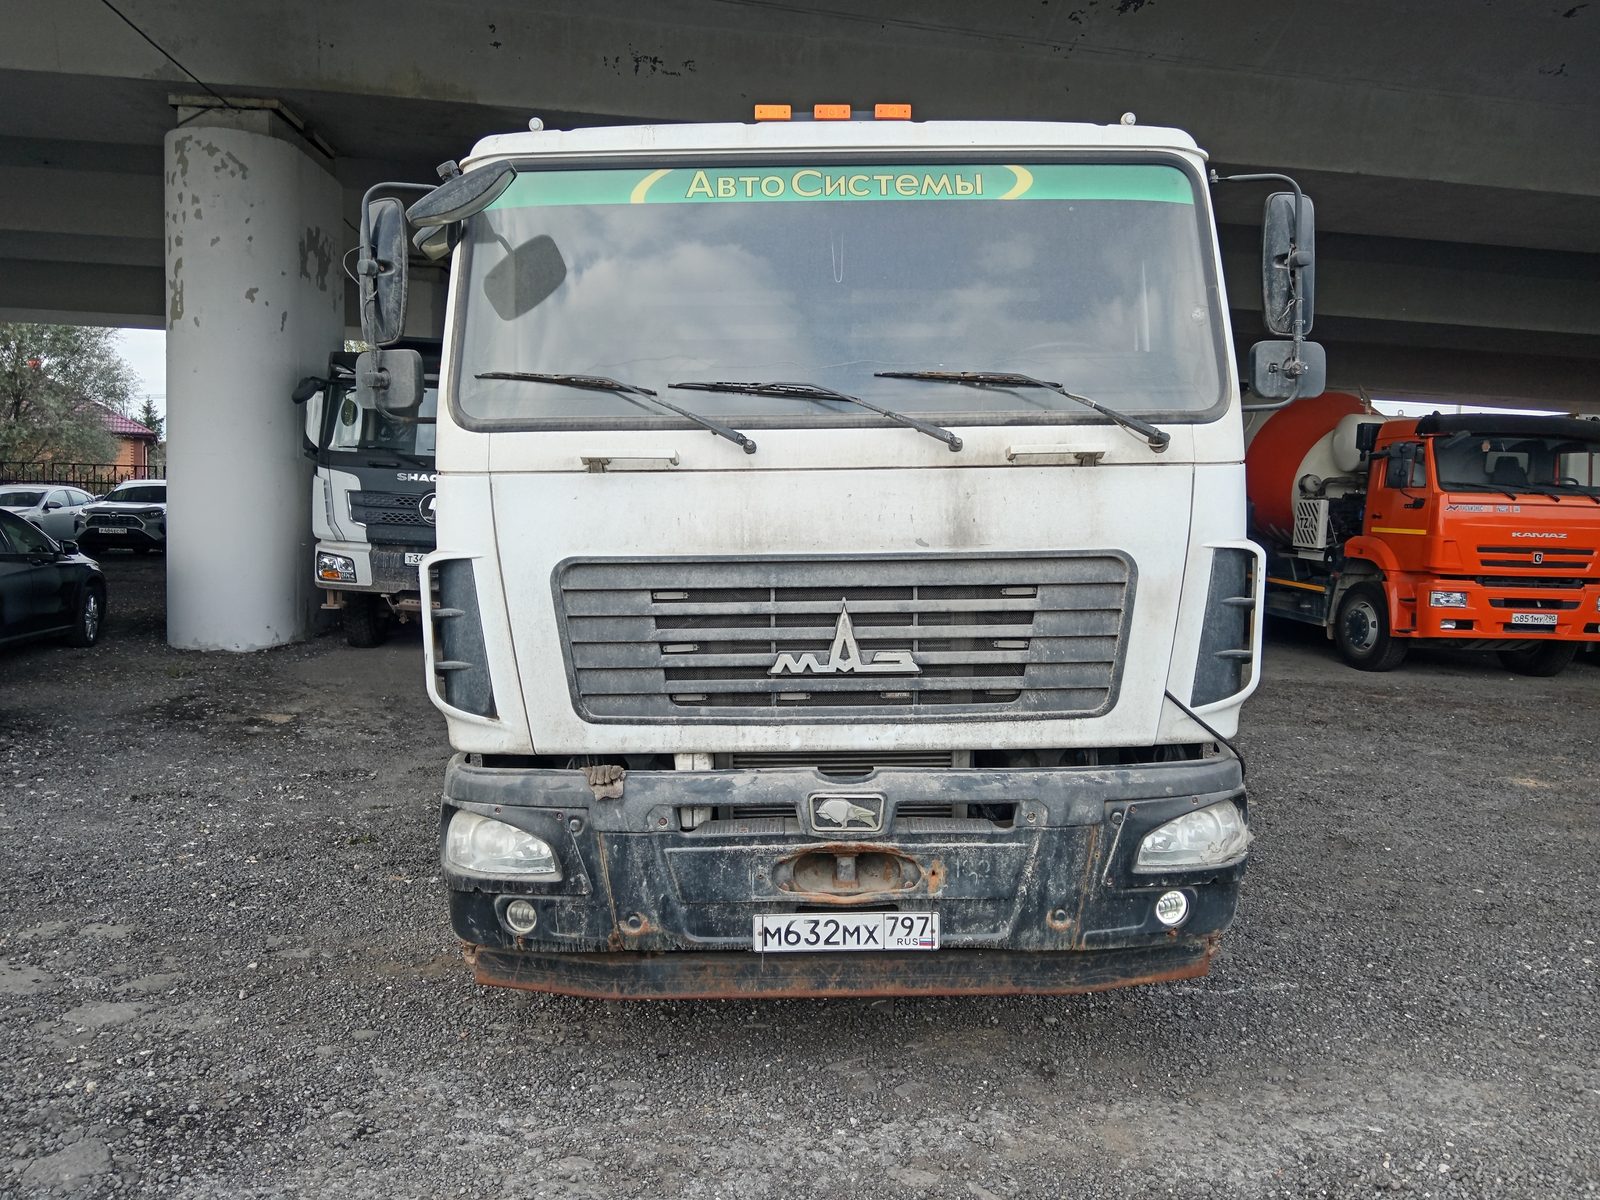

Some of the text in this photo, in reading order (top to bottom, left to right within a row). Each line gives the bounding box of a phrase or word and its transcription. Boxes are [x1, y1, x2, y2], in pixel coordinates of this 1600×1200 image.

[763, 916, 930, 946] М632МХ 797
[896, 937, 919, 946] RUS
